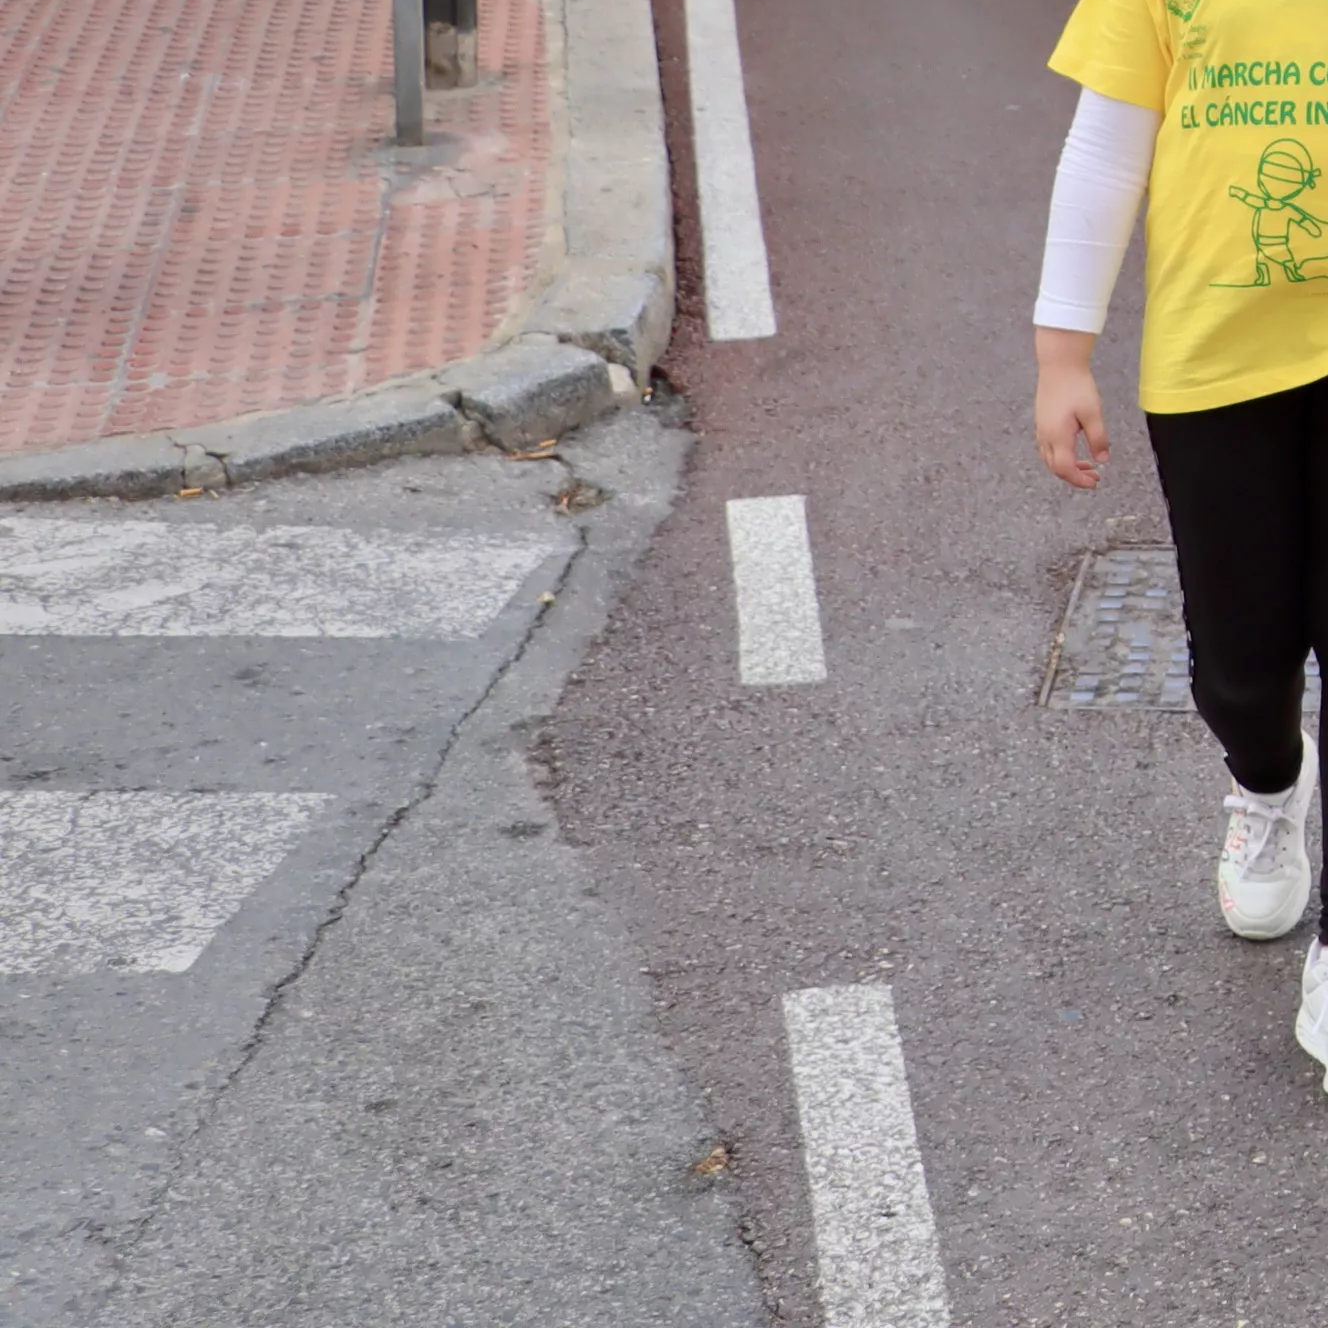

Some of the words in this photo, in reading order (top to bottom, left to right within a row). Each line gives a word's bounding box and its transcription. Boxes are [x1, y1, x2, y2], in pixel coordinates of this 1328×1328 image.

[1188, 65, 1199, 92] II
[1201, 61, 1301, 89] MARCHA
[1181, 104, 1201, 130] EL
[1205, 95, 1297, 128] CÁNCER
